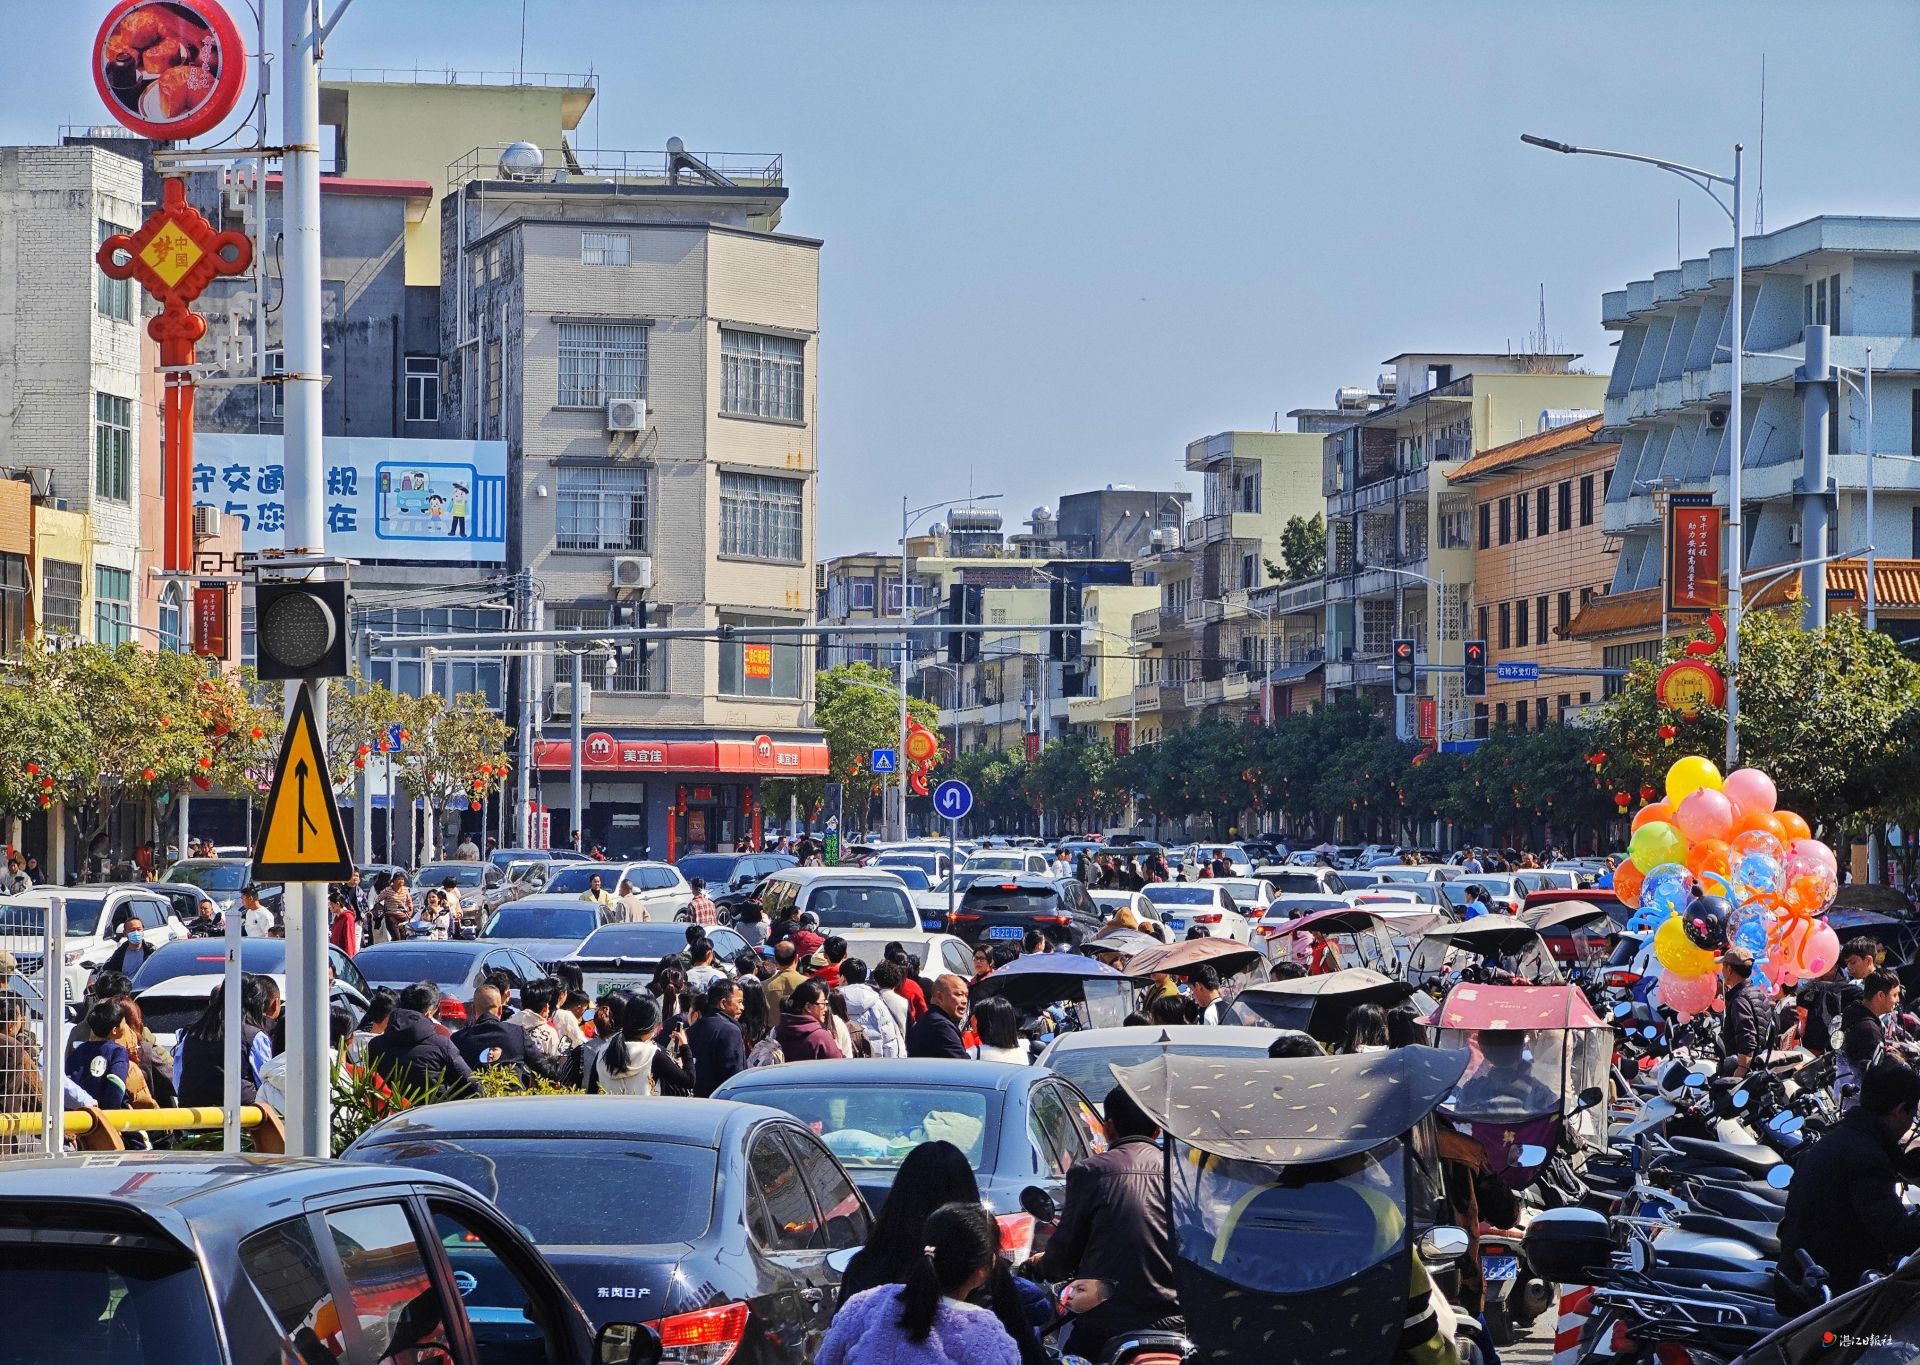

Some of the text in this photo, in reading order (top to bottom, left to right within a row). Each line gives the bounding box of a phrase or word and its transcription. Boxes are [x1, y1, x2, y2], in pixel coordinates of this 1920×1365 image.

[151, 235, 174, 267] 梦
[174, 235, 188, 268] 中国
[192, 463, 357, 496] 守交通规
[624, 750, 663, 763] 美宜佳
[776, 753, 799, 765] 美宜佳
[597, 1287, 651, 1298] 东风日产
